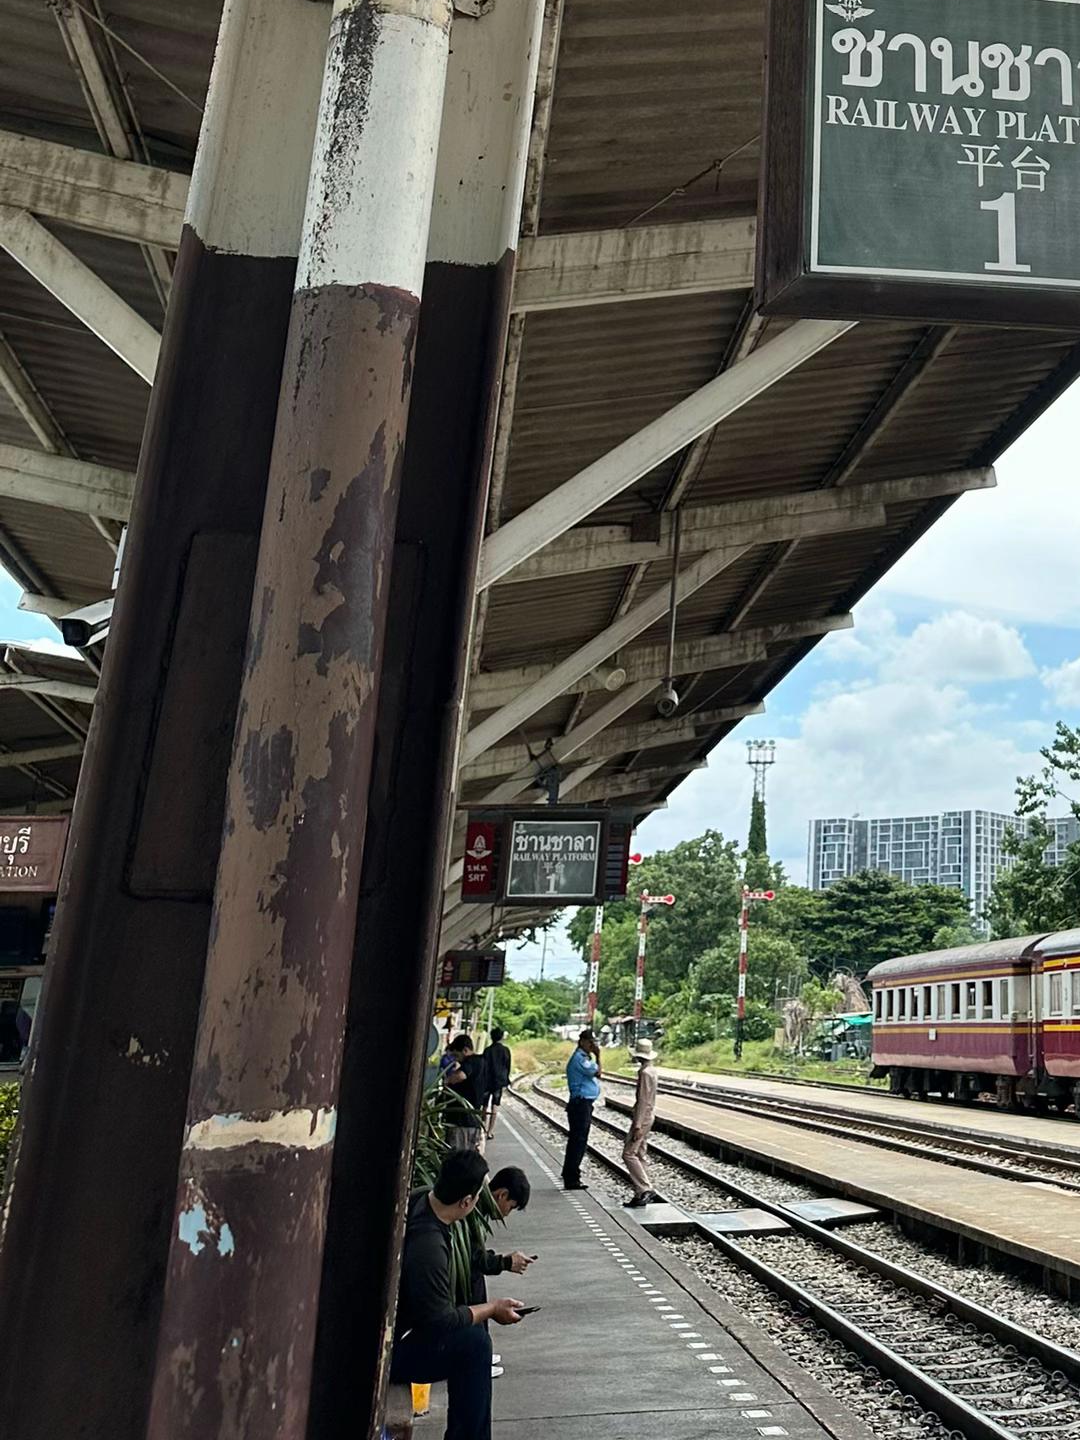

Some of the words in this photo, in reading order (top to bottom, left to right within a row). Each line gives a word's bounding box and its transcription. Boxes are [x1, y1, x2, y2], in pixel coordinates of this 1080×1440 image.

[826, 94, 986, 137] RAILWAY
[957, 143, 1050, 192] 平台
[980, 192, 1031, 273] 1
[0, 826, 31, 865] บุรี
[513, 853, 550, 861] RAILWAY
[552, 853, 596, 861] PLATFORM
[515, 835, 594, 851] ชานชาลา
[468, 873, 486, 882] SRT
[545, 873, 558, 894] 1
